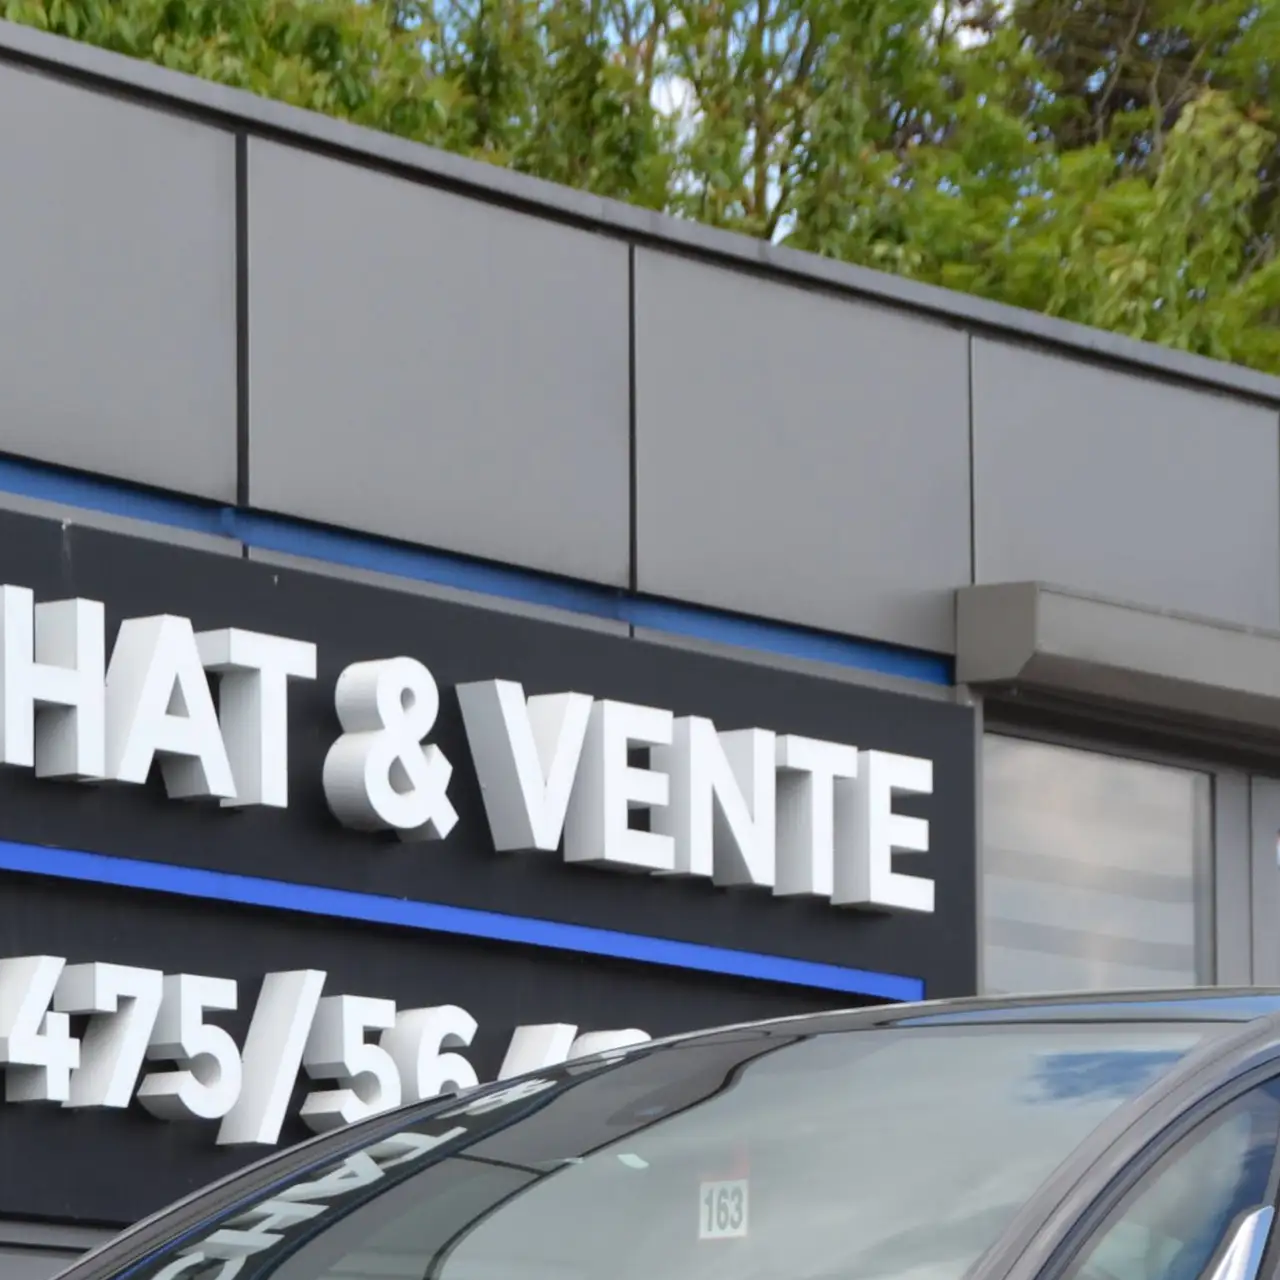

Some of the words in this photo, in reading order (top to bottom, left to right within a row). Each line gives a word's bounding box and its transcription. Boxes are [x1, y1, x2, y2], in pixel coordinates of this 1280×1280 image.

[322, 656, 458, 841] &
[457, 678, 936, 913] VENTE
[704, 1186, 744, 1232] 163
